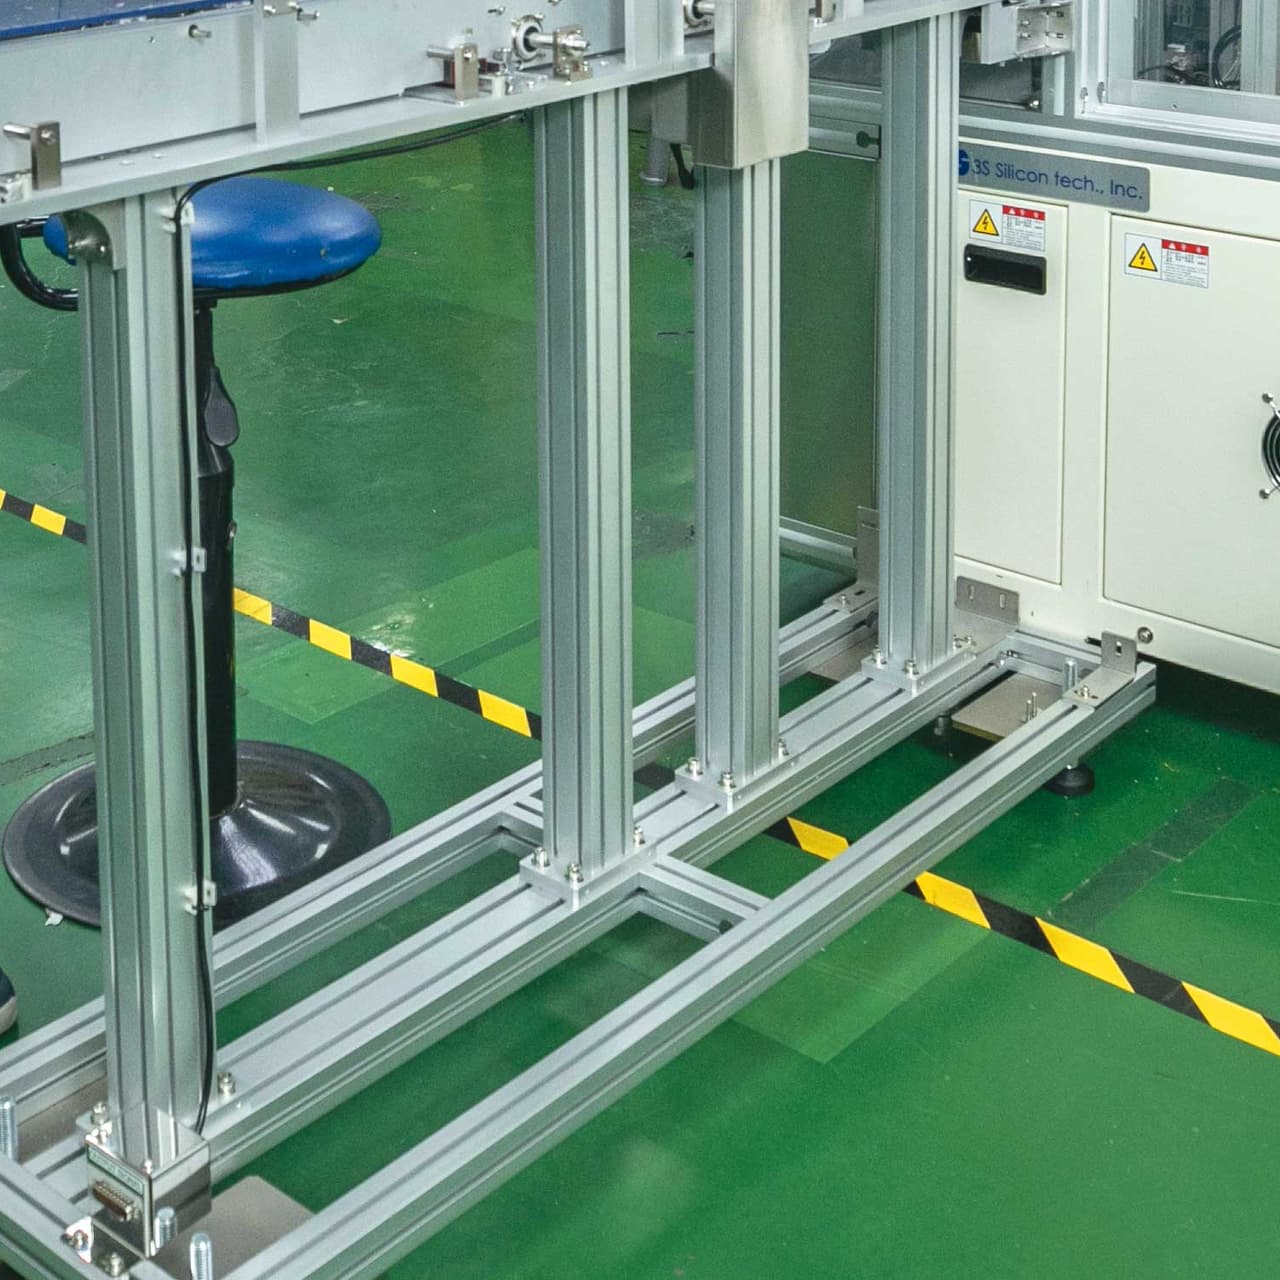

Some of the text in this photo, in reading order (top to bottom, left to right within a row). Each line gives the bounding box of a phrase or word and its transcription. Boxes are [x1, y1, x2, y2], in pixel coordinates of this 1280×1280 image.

[971, 159, 990, 177] 3S
[995, 161, 1049, 185] Silicon
[1110, 179, 1143, 200] Inc.
